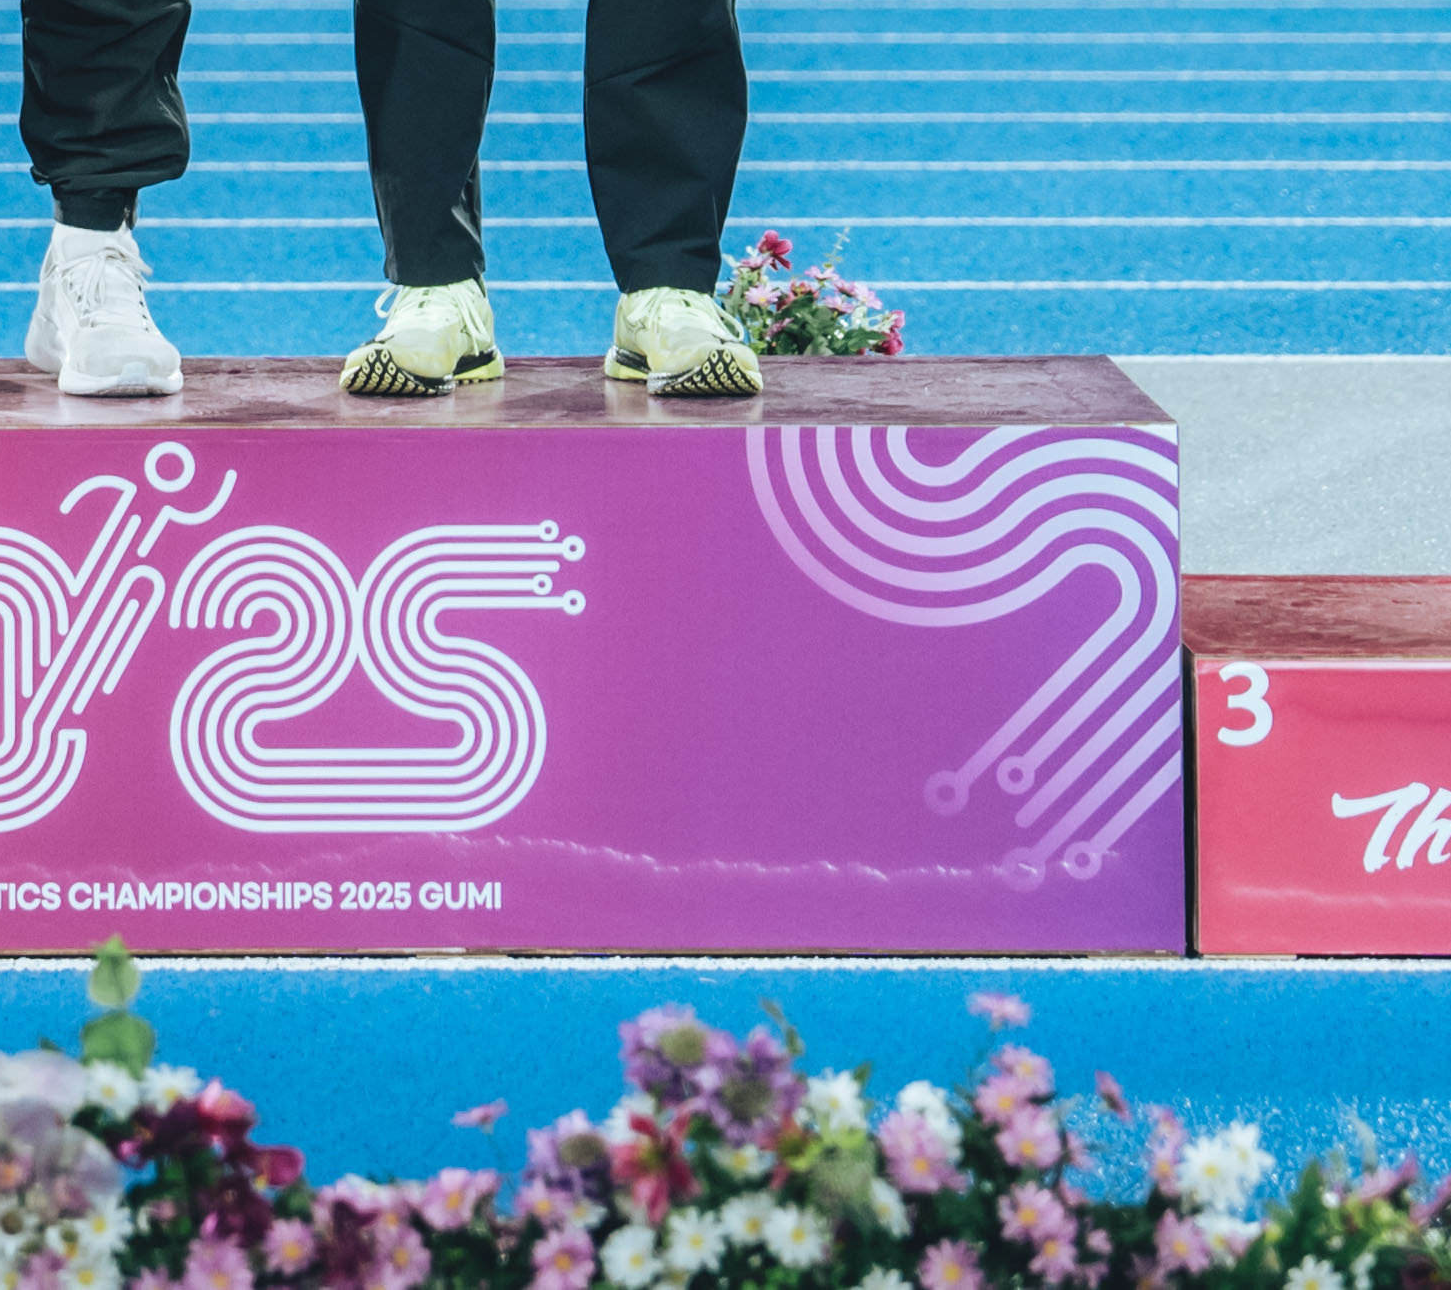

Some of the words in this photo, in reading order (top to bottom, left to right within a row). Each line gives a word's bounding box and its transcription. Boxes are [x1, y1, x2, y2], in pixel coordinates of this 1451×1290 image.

[1217, 661, 1274, 747] 3
[67, 881, 333, 911] CHAMPIONSHIPS
[339, 881, 412, 911] 2025
[418, 881, 502, 911] GUMI
